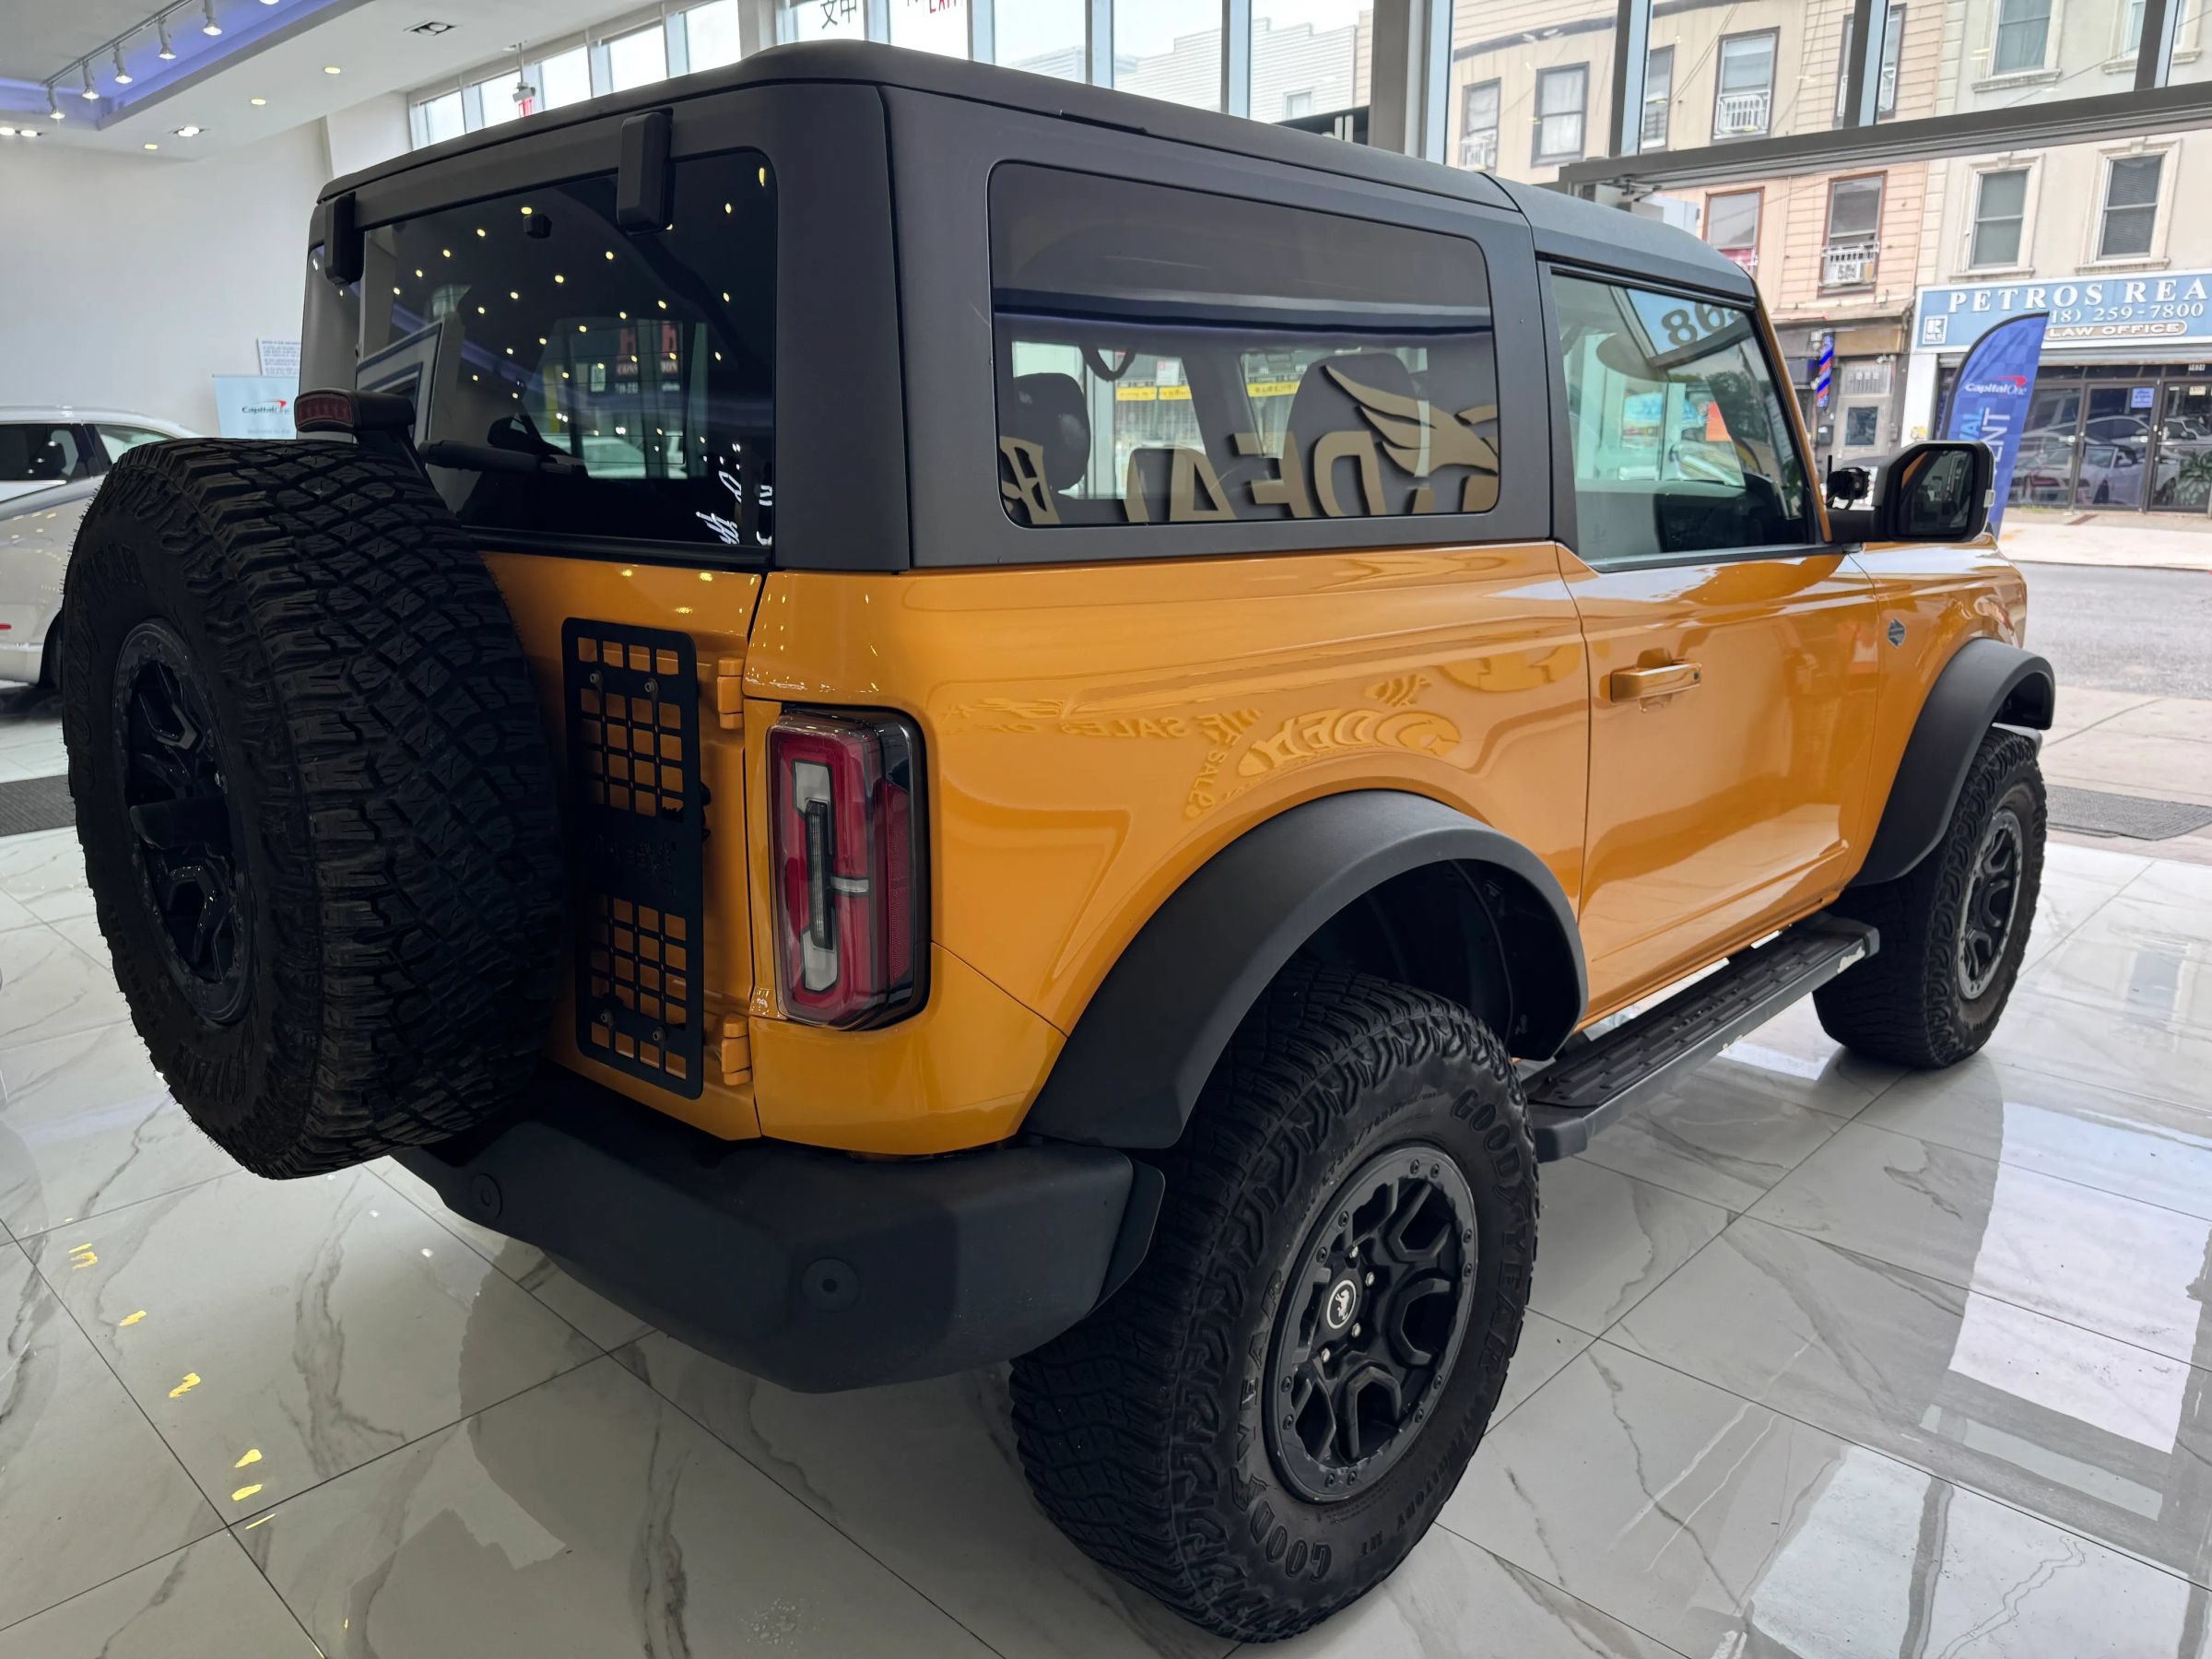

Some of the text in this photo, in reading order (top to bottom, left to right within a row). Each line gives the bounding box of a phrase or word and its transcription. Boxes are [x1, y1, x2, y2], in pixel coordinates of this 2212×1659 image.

[1947, 278, 2207, 313] PETROS REA
[2049, 323, 2181, 337] LAW OFFICE
[1450, 1088, 1532, 1372] GOODYEAR
[1230, 1269, 1332, 1583] GOODYEAR
